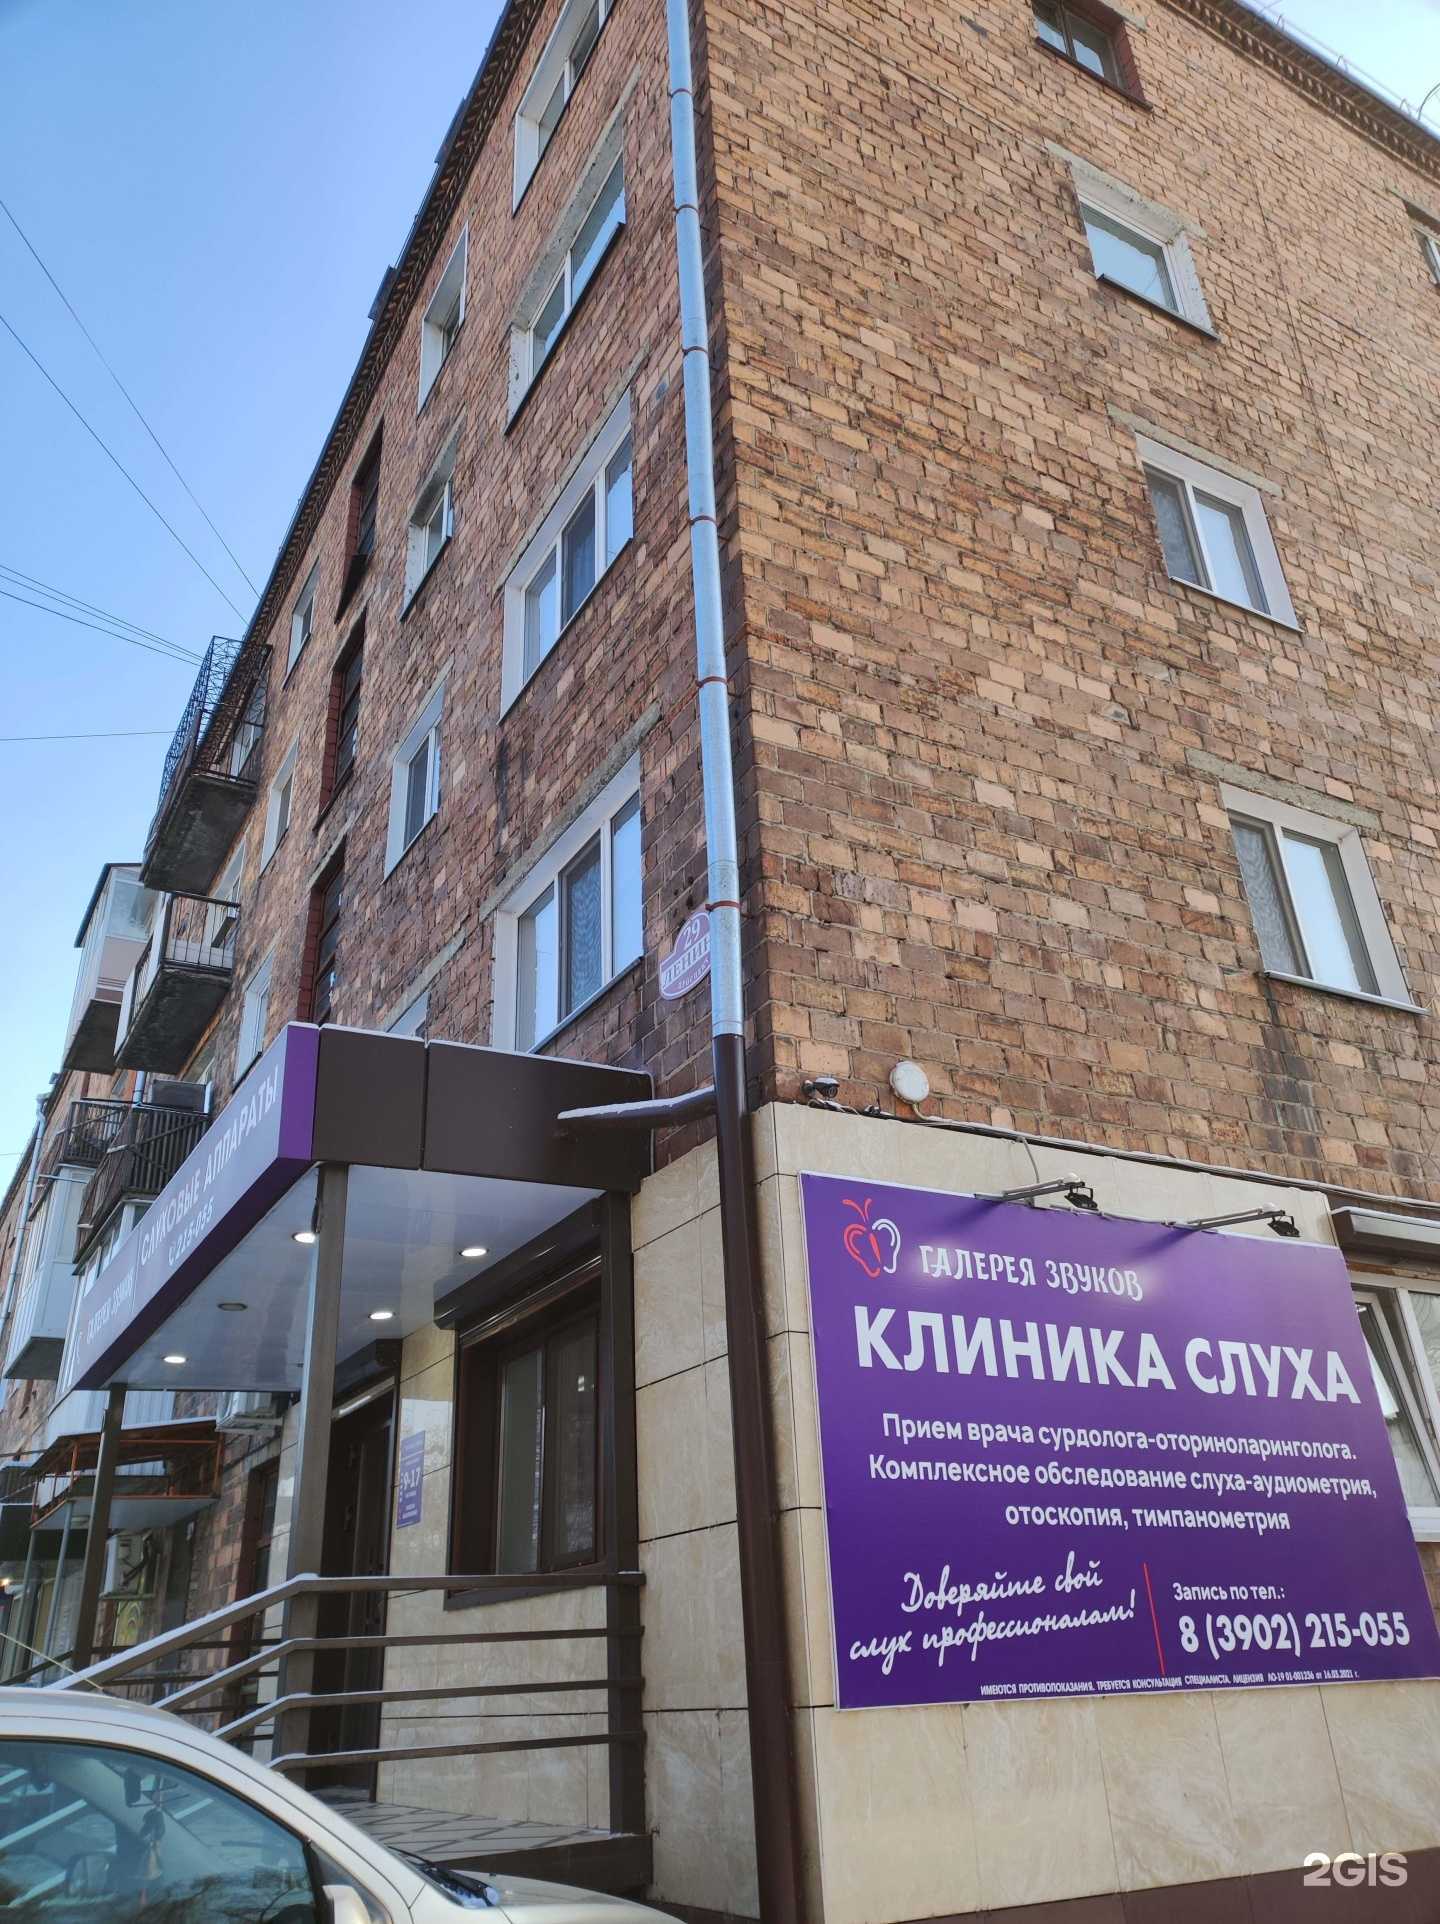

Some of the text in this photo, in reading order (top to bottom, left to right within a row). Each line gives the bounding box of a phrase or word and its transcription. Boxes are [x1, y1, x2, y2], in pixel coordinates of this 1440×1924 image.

[683, 919, 700, 951] 29
[141, 1064, 279, 1266] СЛУХОВЫЕ АППАРАТЫ
[920, 1245, 1143, 1301] ГАЛЕРЕЯ ЗВУКОВ
[854, 1306, 1361, 1404] КЛИНИКА СЛУХА
[882, 1413, 1357, 1460] Прием врача сурдолога-оториноларинголога.
[869, 1454, 1377, 1500] Комплексное обследование слуха-аудиометрия,
[1005, 1505, 1290, 1535] отоскопия, тимпанометрия
[901, 1551, 1102, 1617] Доверяйте свой
[1173, 1583, 1285, 1602] Запись по тел.:
[849, 1589, 1135, 1675] слух профессионалам!
[1179, 1611, 1410, 1660] 8 (3902) 215-055
[981, 1684, 1016, 1696] ИМЕЮТСЯ
[1019, 1681, 1095, 1694] ПРОТИВОПОКАЗАНИЯ.
[1097, 1679, 1130, 1690] ТРЕБУЕТСЯ
[1132, 1677, 1182, 1689] КОНСУЛЬТАЦИЯ
